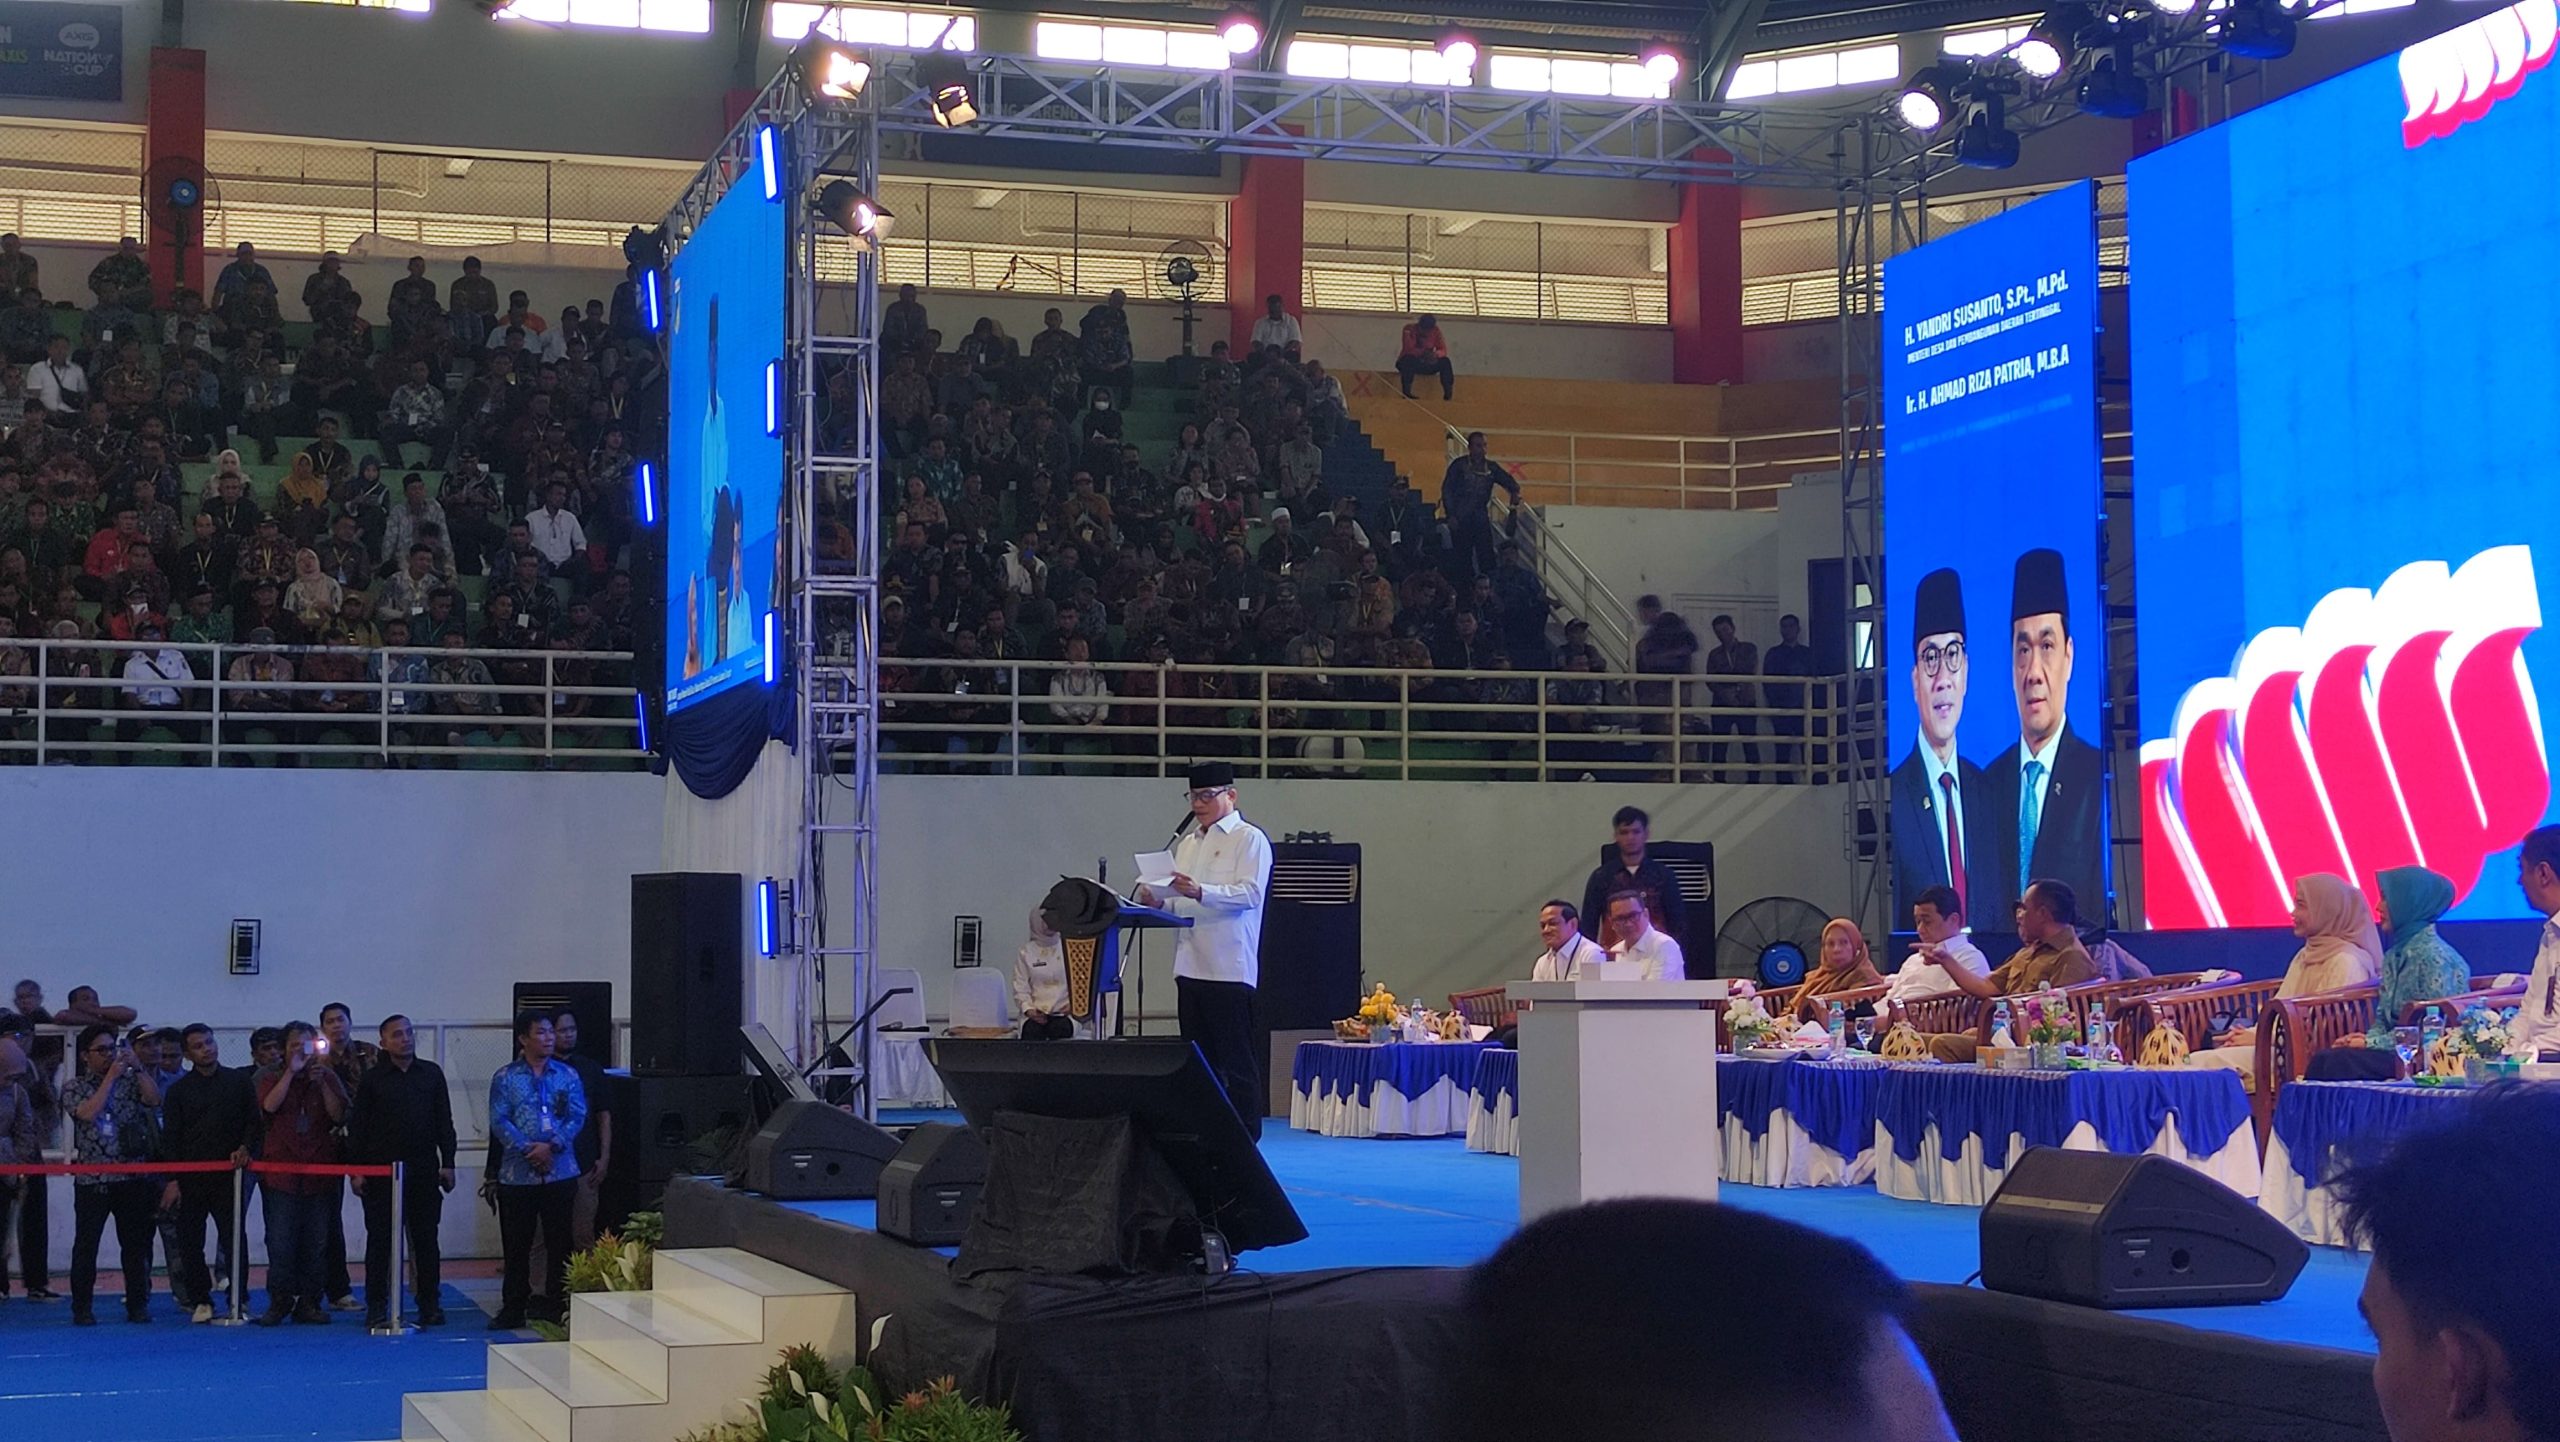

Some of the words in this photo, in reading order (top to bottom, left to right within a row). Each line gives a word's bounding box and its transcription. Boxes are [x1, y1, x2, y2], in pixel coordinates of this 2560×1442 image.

[74, 64, 104, 76] CUP
[1905, 326, 1916, 346] H.
[1917, 312, 1951, 340] YANDRI
[1953, 293, 2004, 329] SUSANTO,
[2037, 269, 2069, 298] M.Pd.
[1906, 395, 1917, 414] Ir.
[1918, 390, 1929, 409] H.
[1930, 377, 1966, 406] AHMAD
[1968, 368, 1992, 394] RIZA
[1994, 356, 2035, 386] PATRIA,
[2037, 344, 2069, 373] M.B.A
